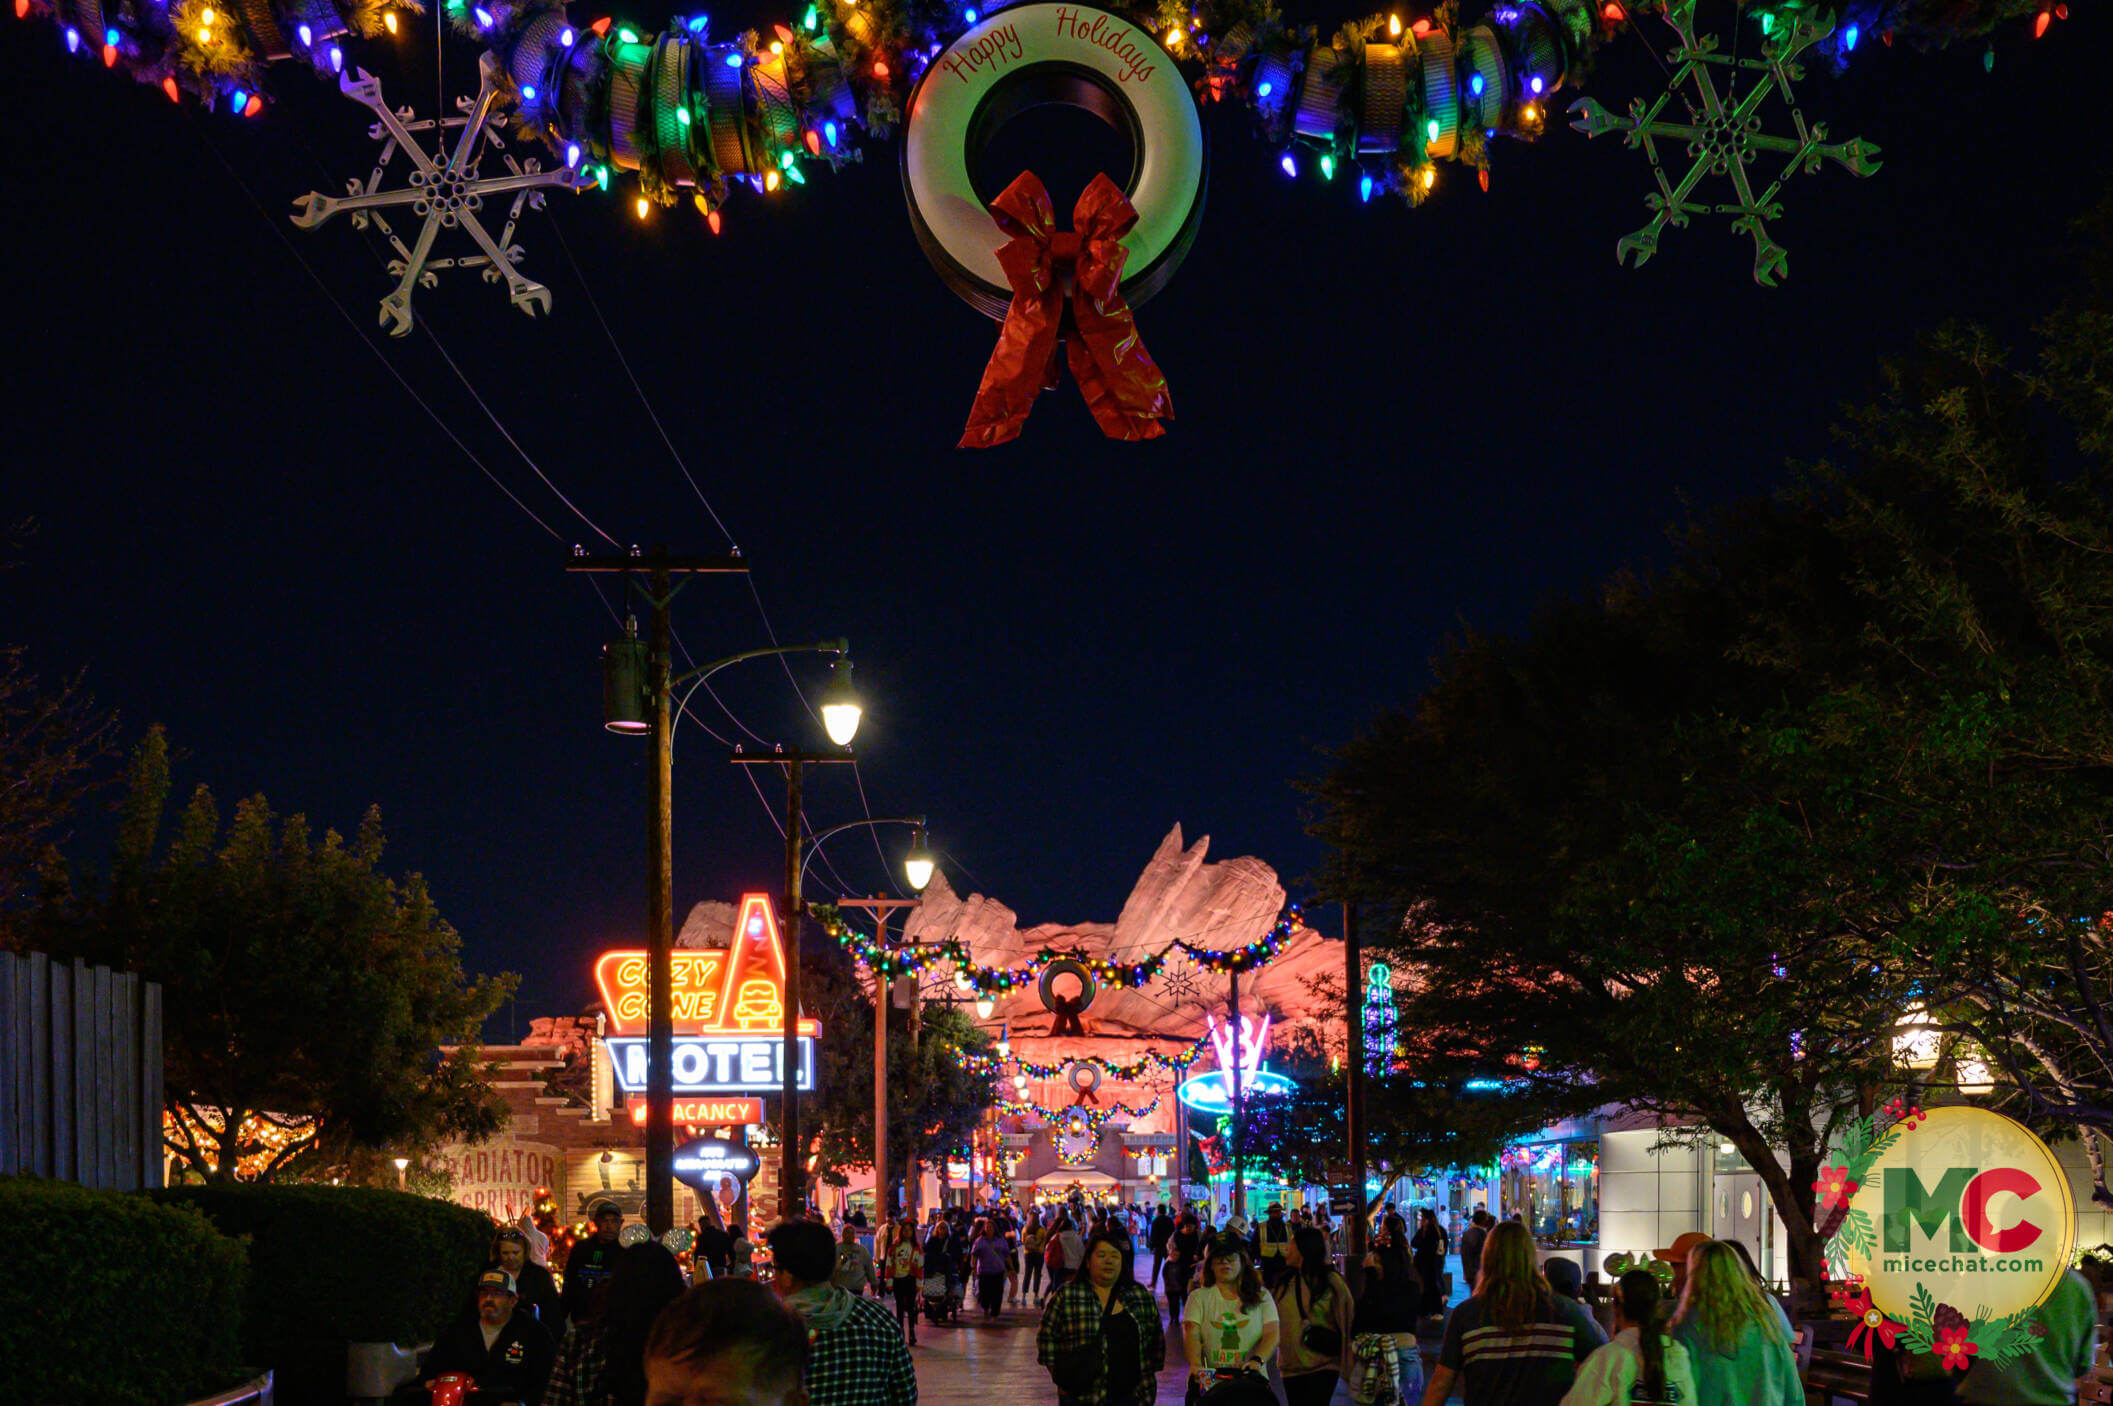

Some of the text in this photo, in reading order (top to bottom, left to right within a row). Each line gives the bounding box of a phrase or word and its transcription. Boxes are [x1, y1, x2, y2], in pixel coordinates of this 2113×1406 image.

[943, 7, 1155, 83] Happy Holidays
[617, 958, 717, 987] CZY
[618, 991, 716, 1020] CNE
[673, 1103, 750, 1120] ACANCY
[446, 1149, 554, 1188] RADIATOR
[462, 1188, 533, 1218] SPRING
